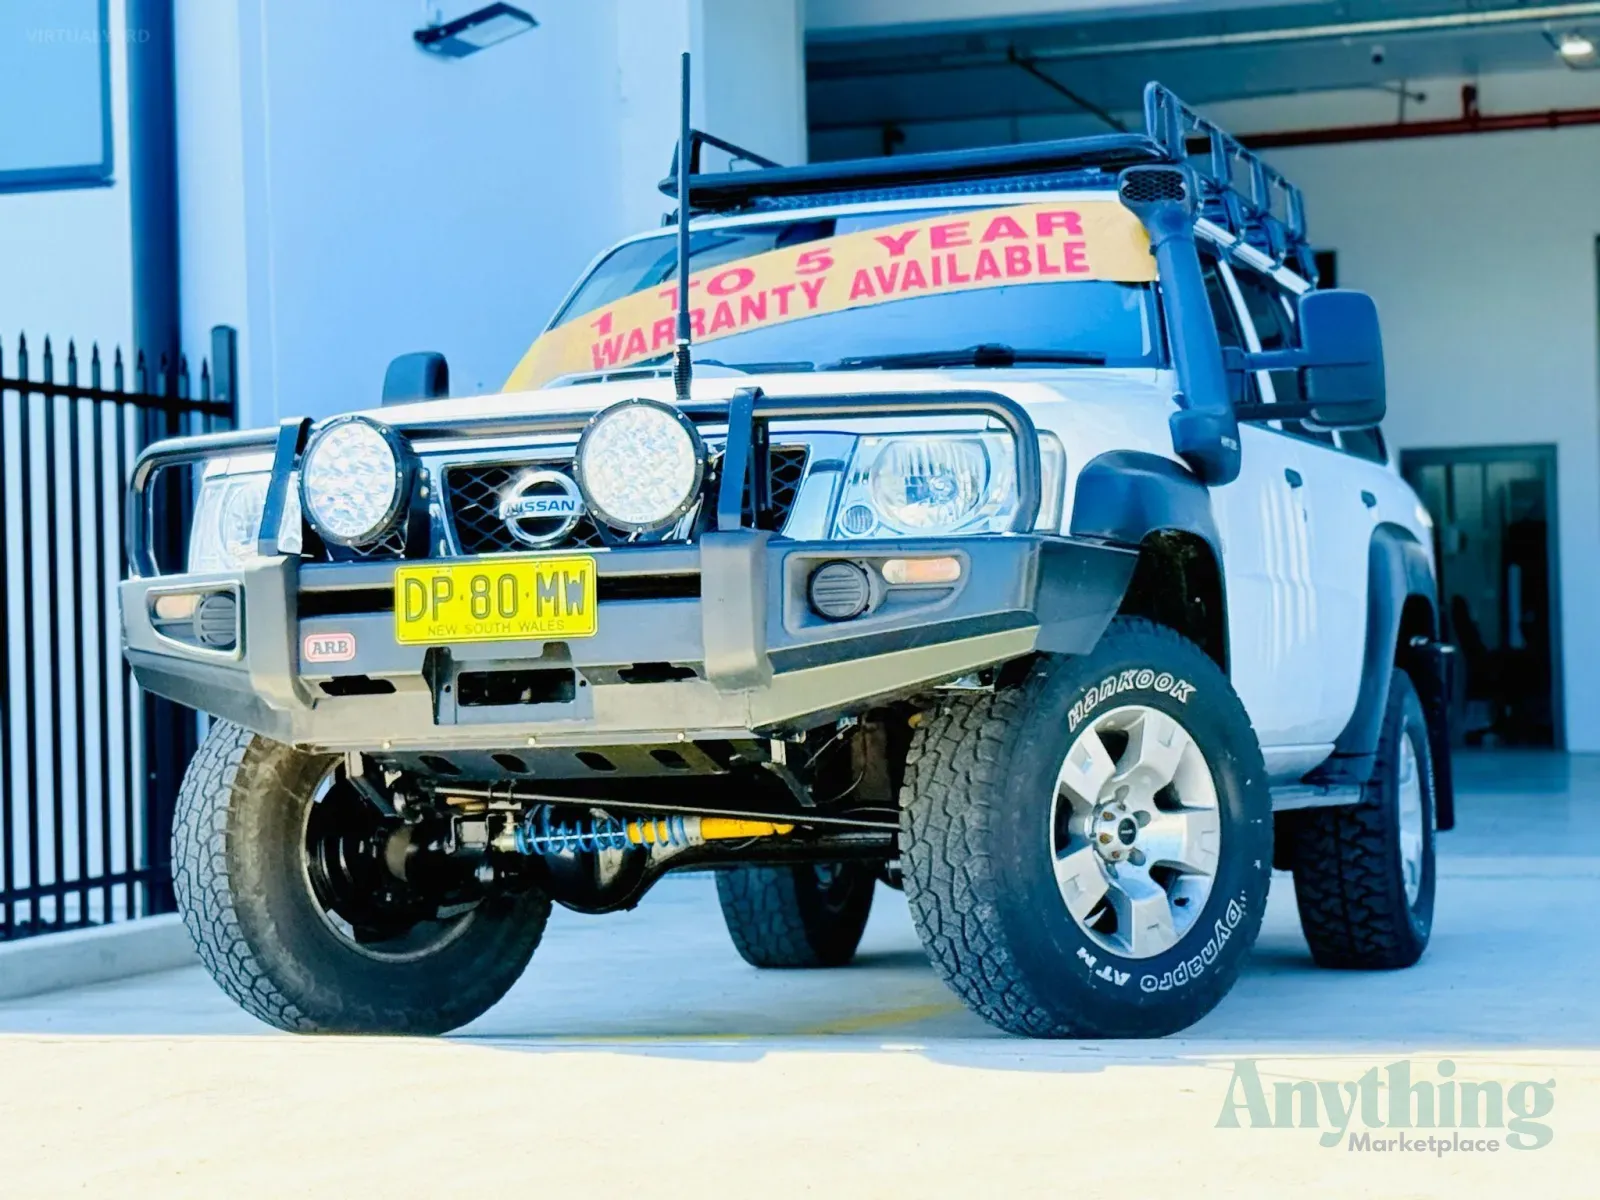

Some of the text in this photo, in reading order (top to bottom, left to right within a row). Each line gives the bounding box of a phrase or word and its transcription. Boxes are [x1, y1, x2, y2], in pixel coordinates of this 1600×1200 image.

[590, 211, 1084, 336] 1 TO 5 YEAR
[591, 242, 1090, 371] WARRANTY AVAILABLE
[506, 499, 576, 515] NISSAN
[404, 570, 586, 623] DP 80 MW
[428, 620, 565, 636] NEW SOUTH WALES
[311, 640, 349, 655] ARB
